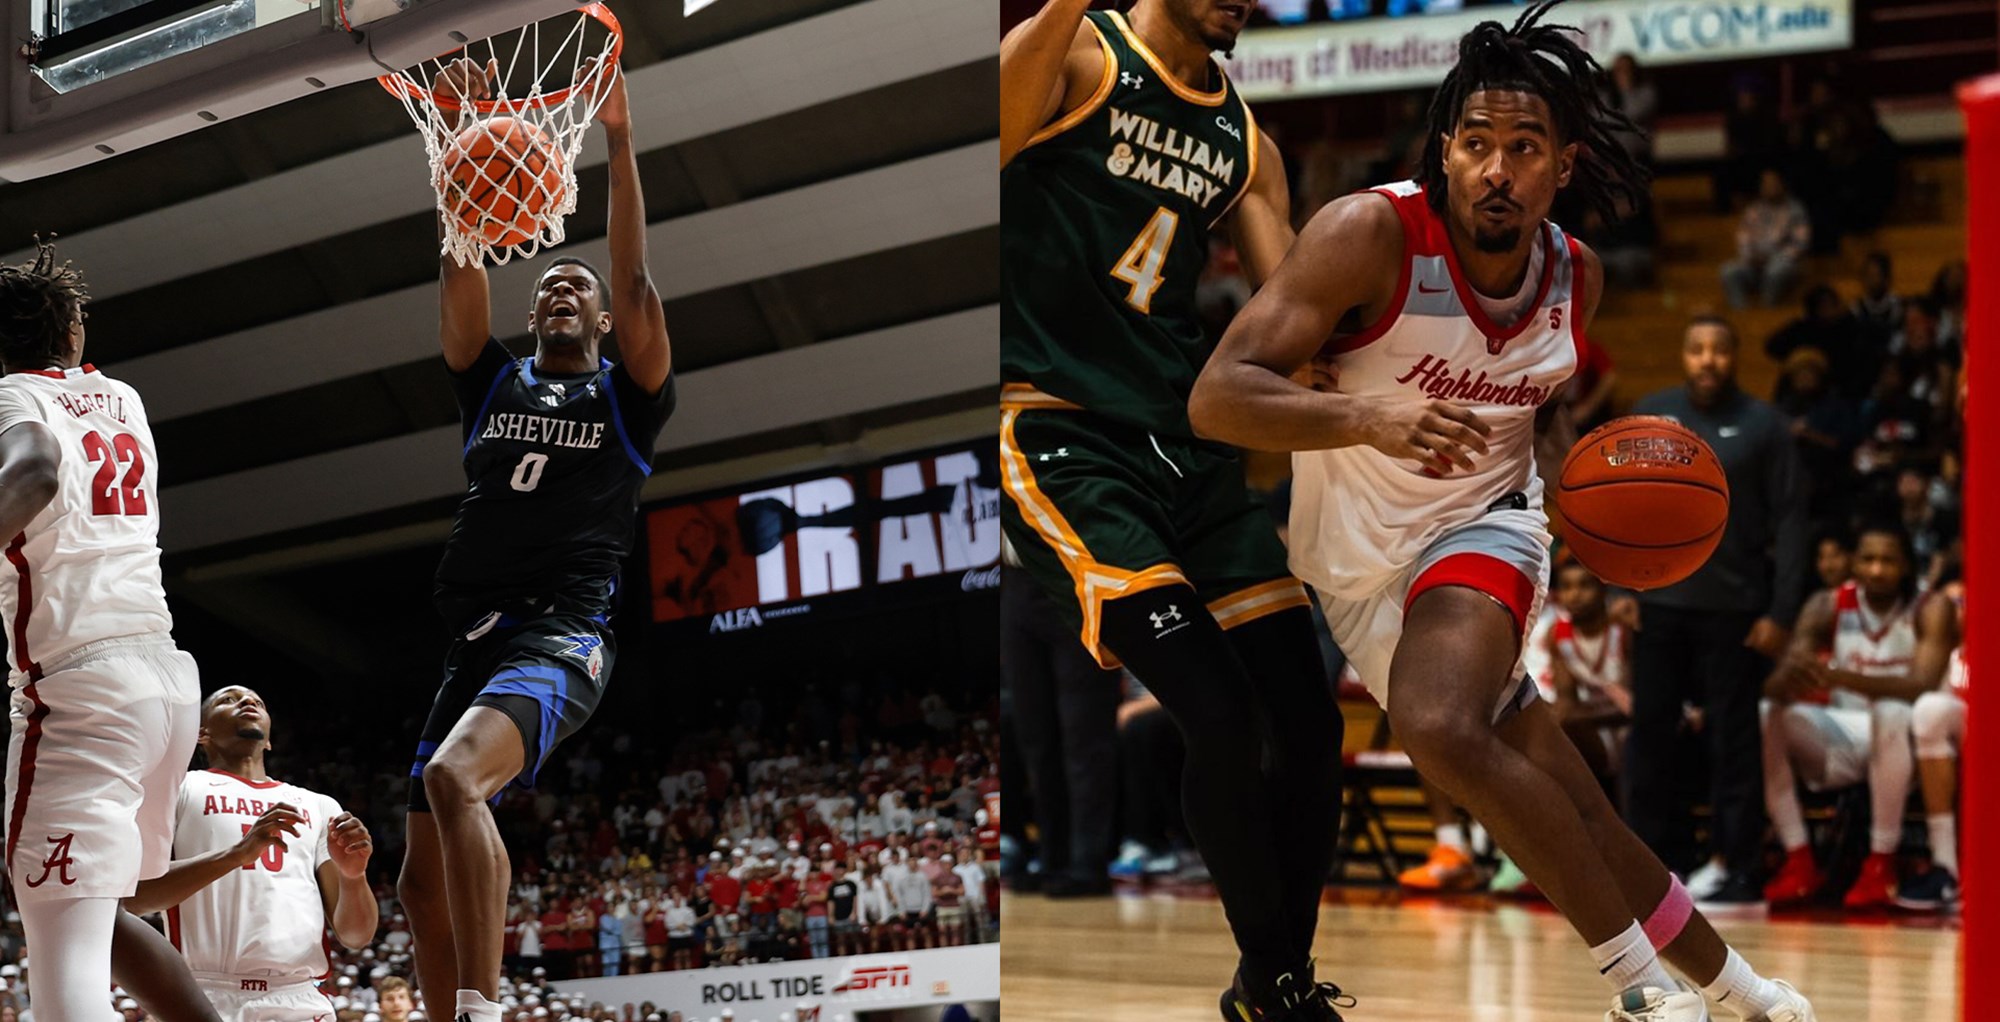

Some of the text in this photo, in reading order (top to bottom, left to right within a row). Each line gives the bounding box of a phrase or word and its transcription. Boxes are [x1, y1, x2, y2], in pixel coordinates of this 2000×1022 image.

[1349, 36, 1460, 72] Medica
[1109, 106, 1235, 186] WILLIAM
[1215, 115, 1241, 142] CAA
[1110, 206, 1179, 315] 4
[1395, 354, 1551, 406] Highlanders
[482, 413, 605, 449] ASHEVILLE
[82, 430, 148, 516] 22
[510, 452, 549, 492] 0
[709, 606, 763, 634] ALFA
[203, 795, 312, 829] ALABA
[240, 979, 268, 991] RTR
[702, 975, 824, 1004] ROLL TIDE
[832, 965, 910, 993] ESPN
